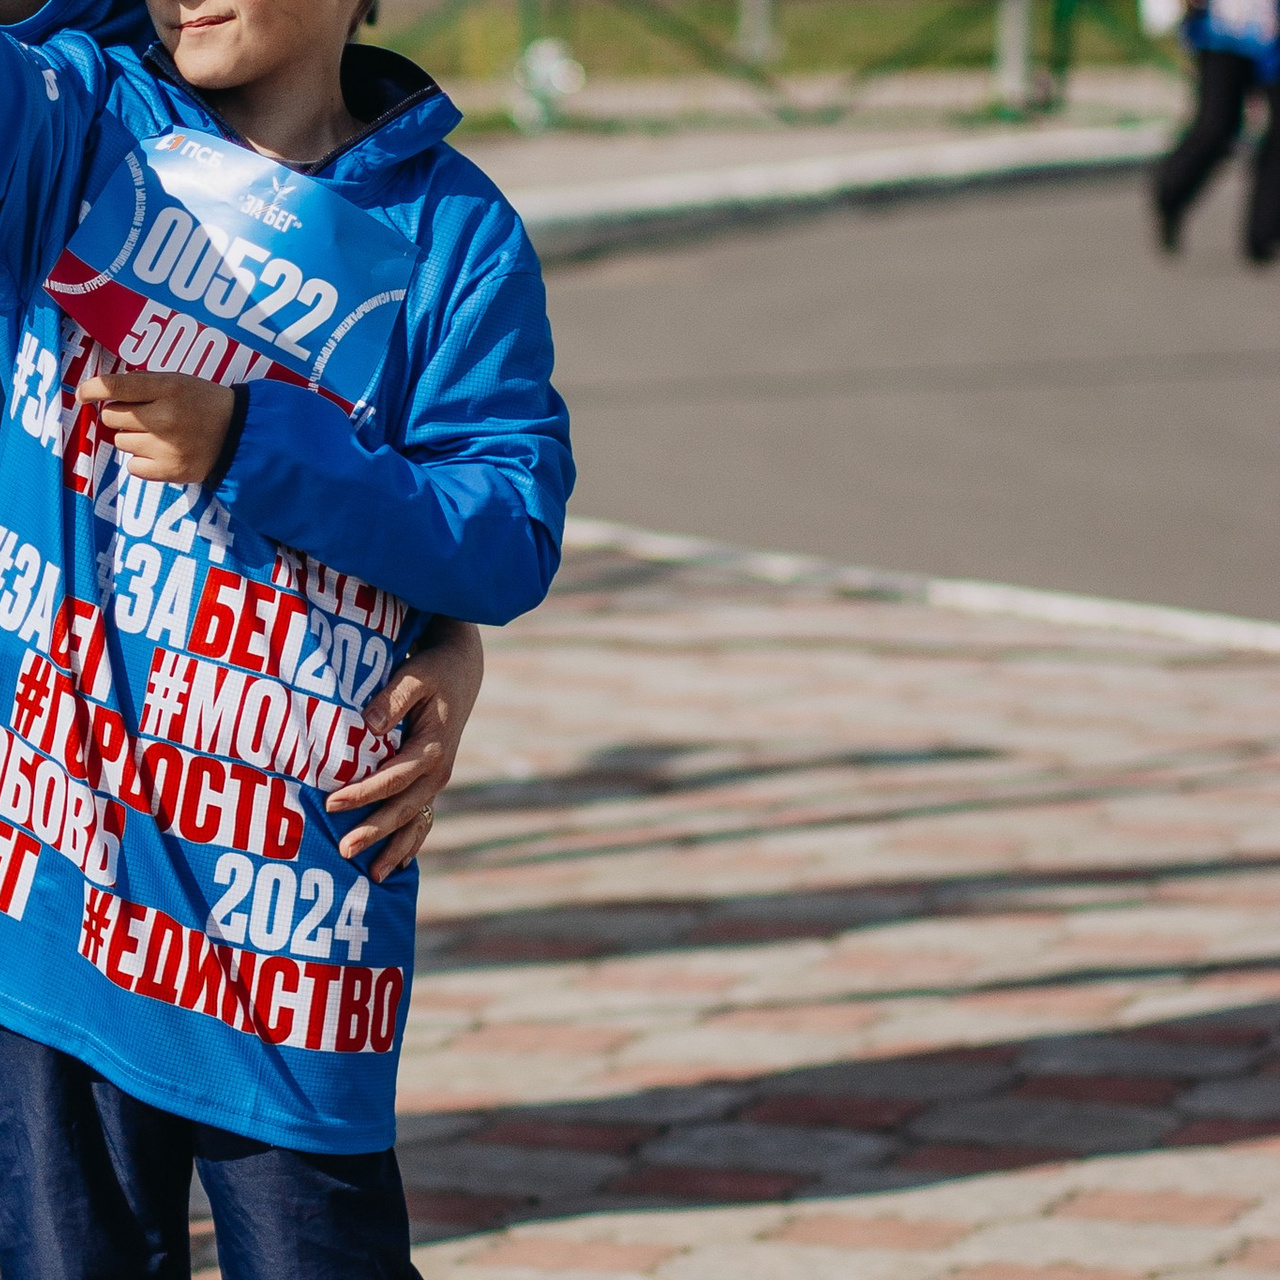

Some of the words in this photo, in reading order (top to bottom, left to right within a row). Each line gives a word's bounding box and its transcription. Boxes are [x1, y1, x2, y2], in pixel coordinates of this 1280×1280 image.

[132, 187, 147, 229] #ВОСТОРГ
[180, 140, 225, 168] ПСБ
[133, 206, 339, 362] 00522
[206, 852, 371, 961] 2024
[78, 881, 404, 1055] #ЕДИНСТВО
